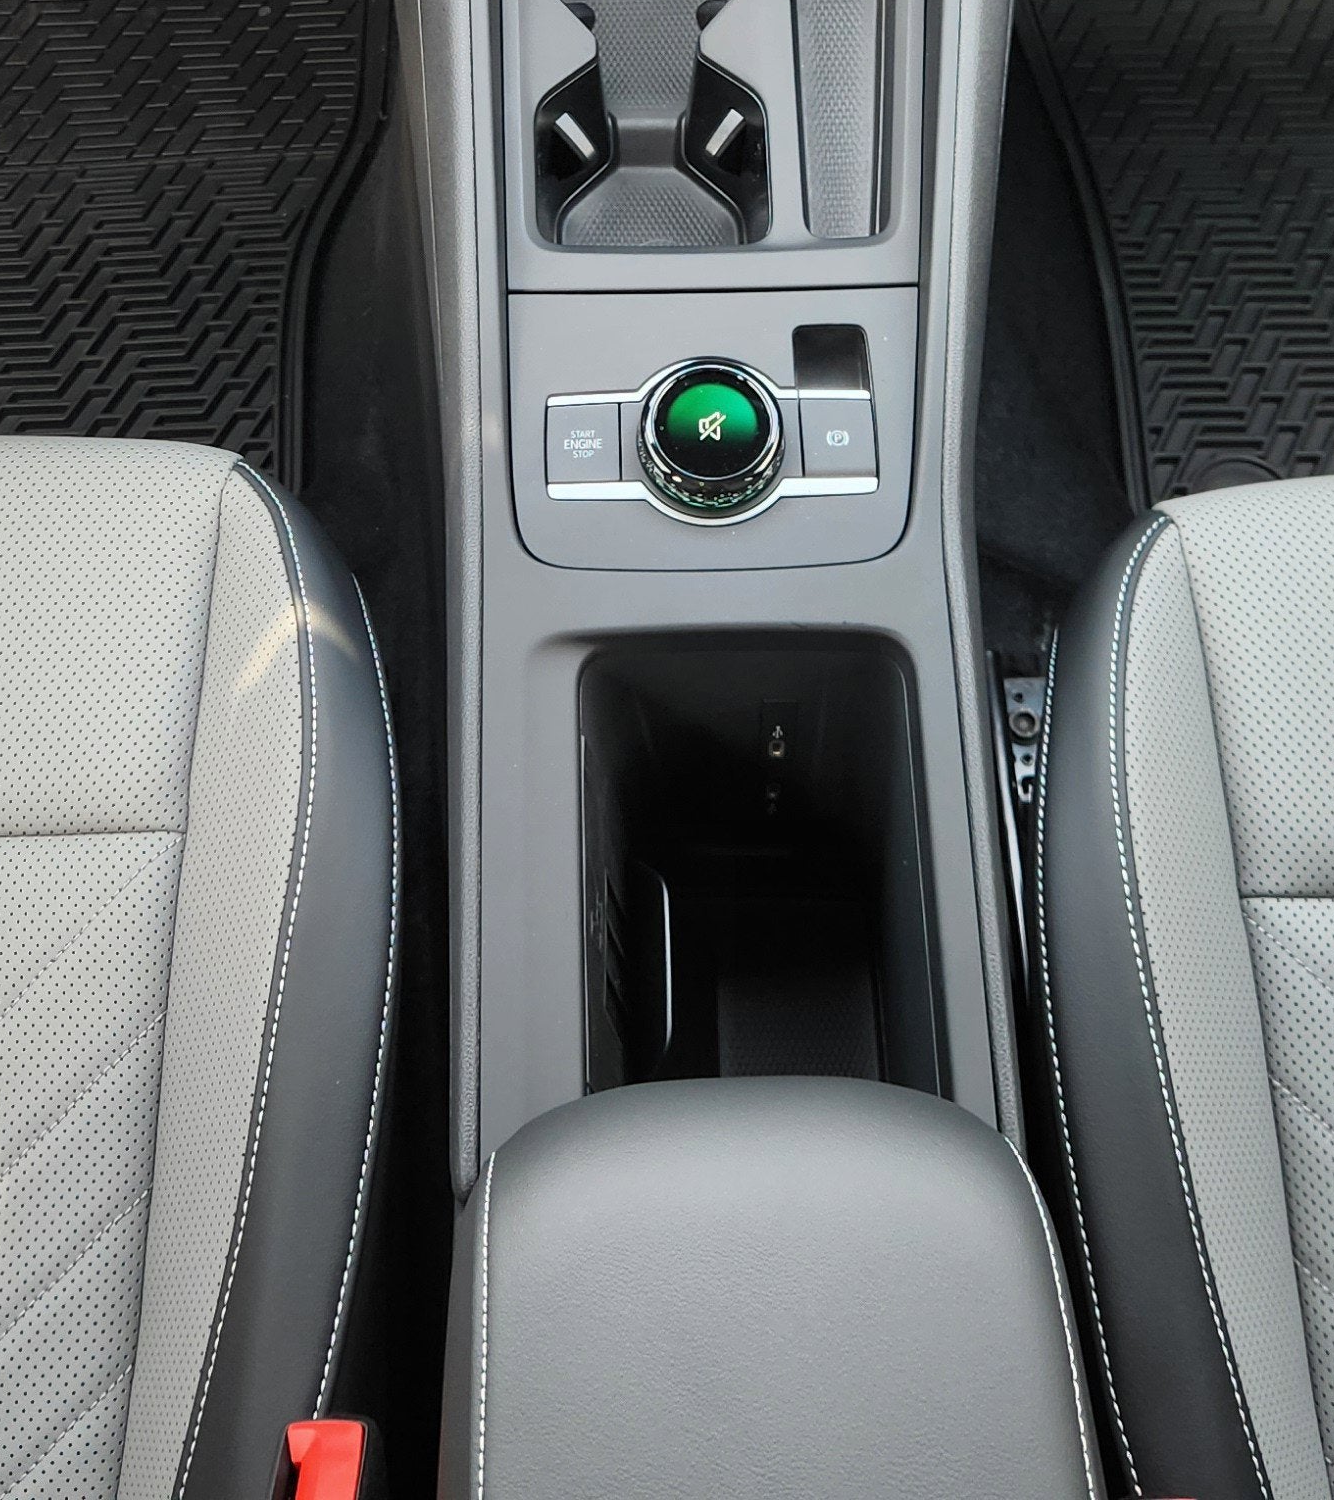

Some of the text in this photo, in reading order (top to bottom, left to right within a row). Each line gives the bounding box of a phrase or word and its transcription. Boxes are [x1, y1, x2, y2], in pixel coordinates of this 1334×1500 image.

[570, 429, 595, 439] START
[563, 438, 603, 450] ENGINE
[572, 450, 595, 459] STOP
